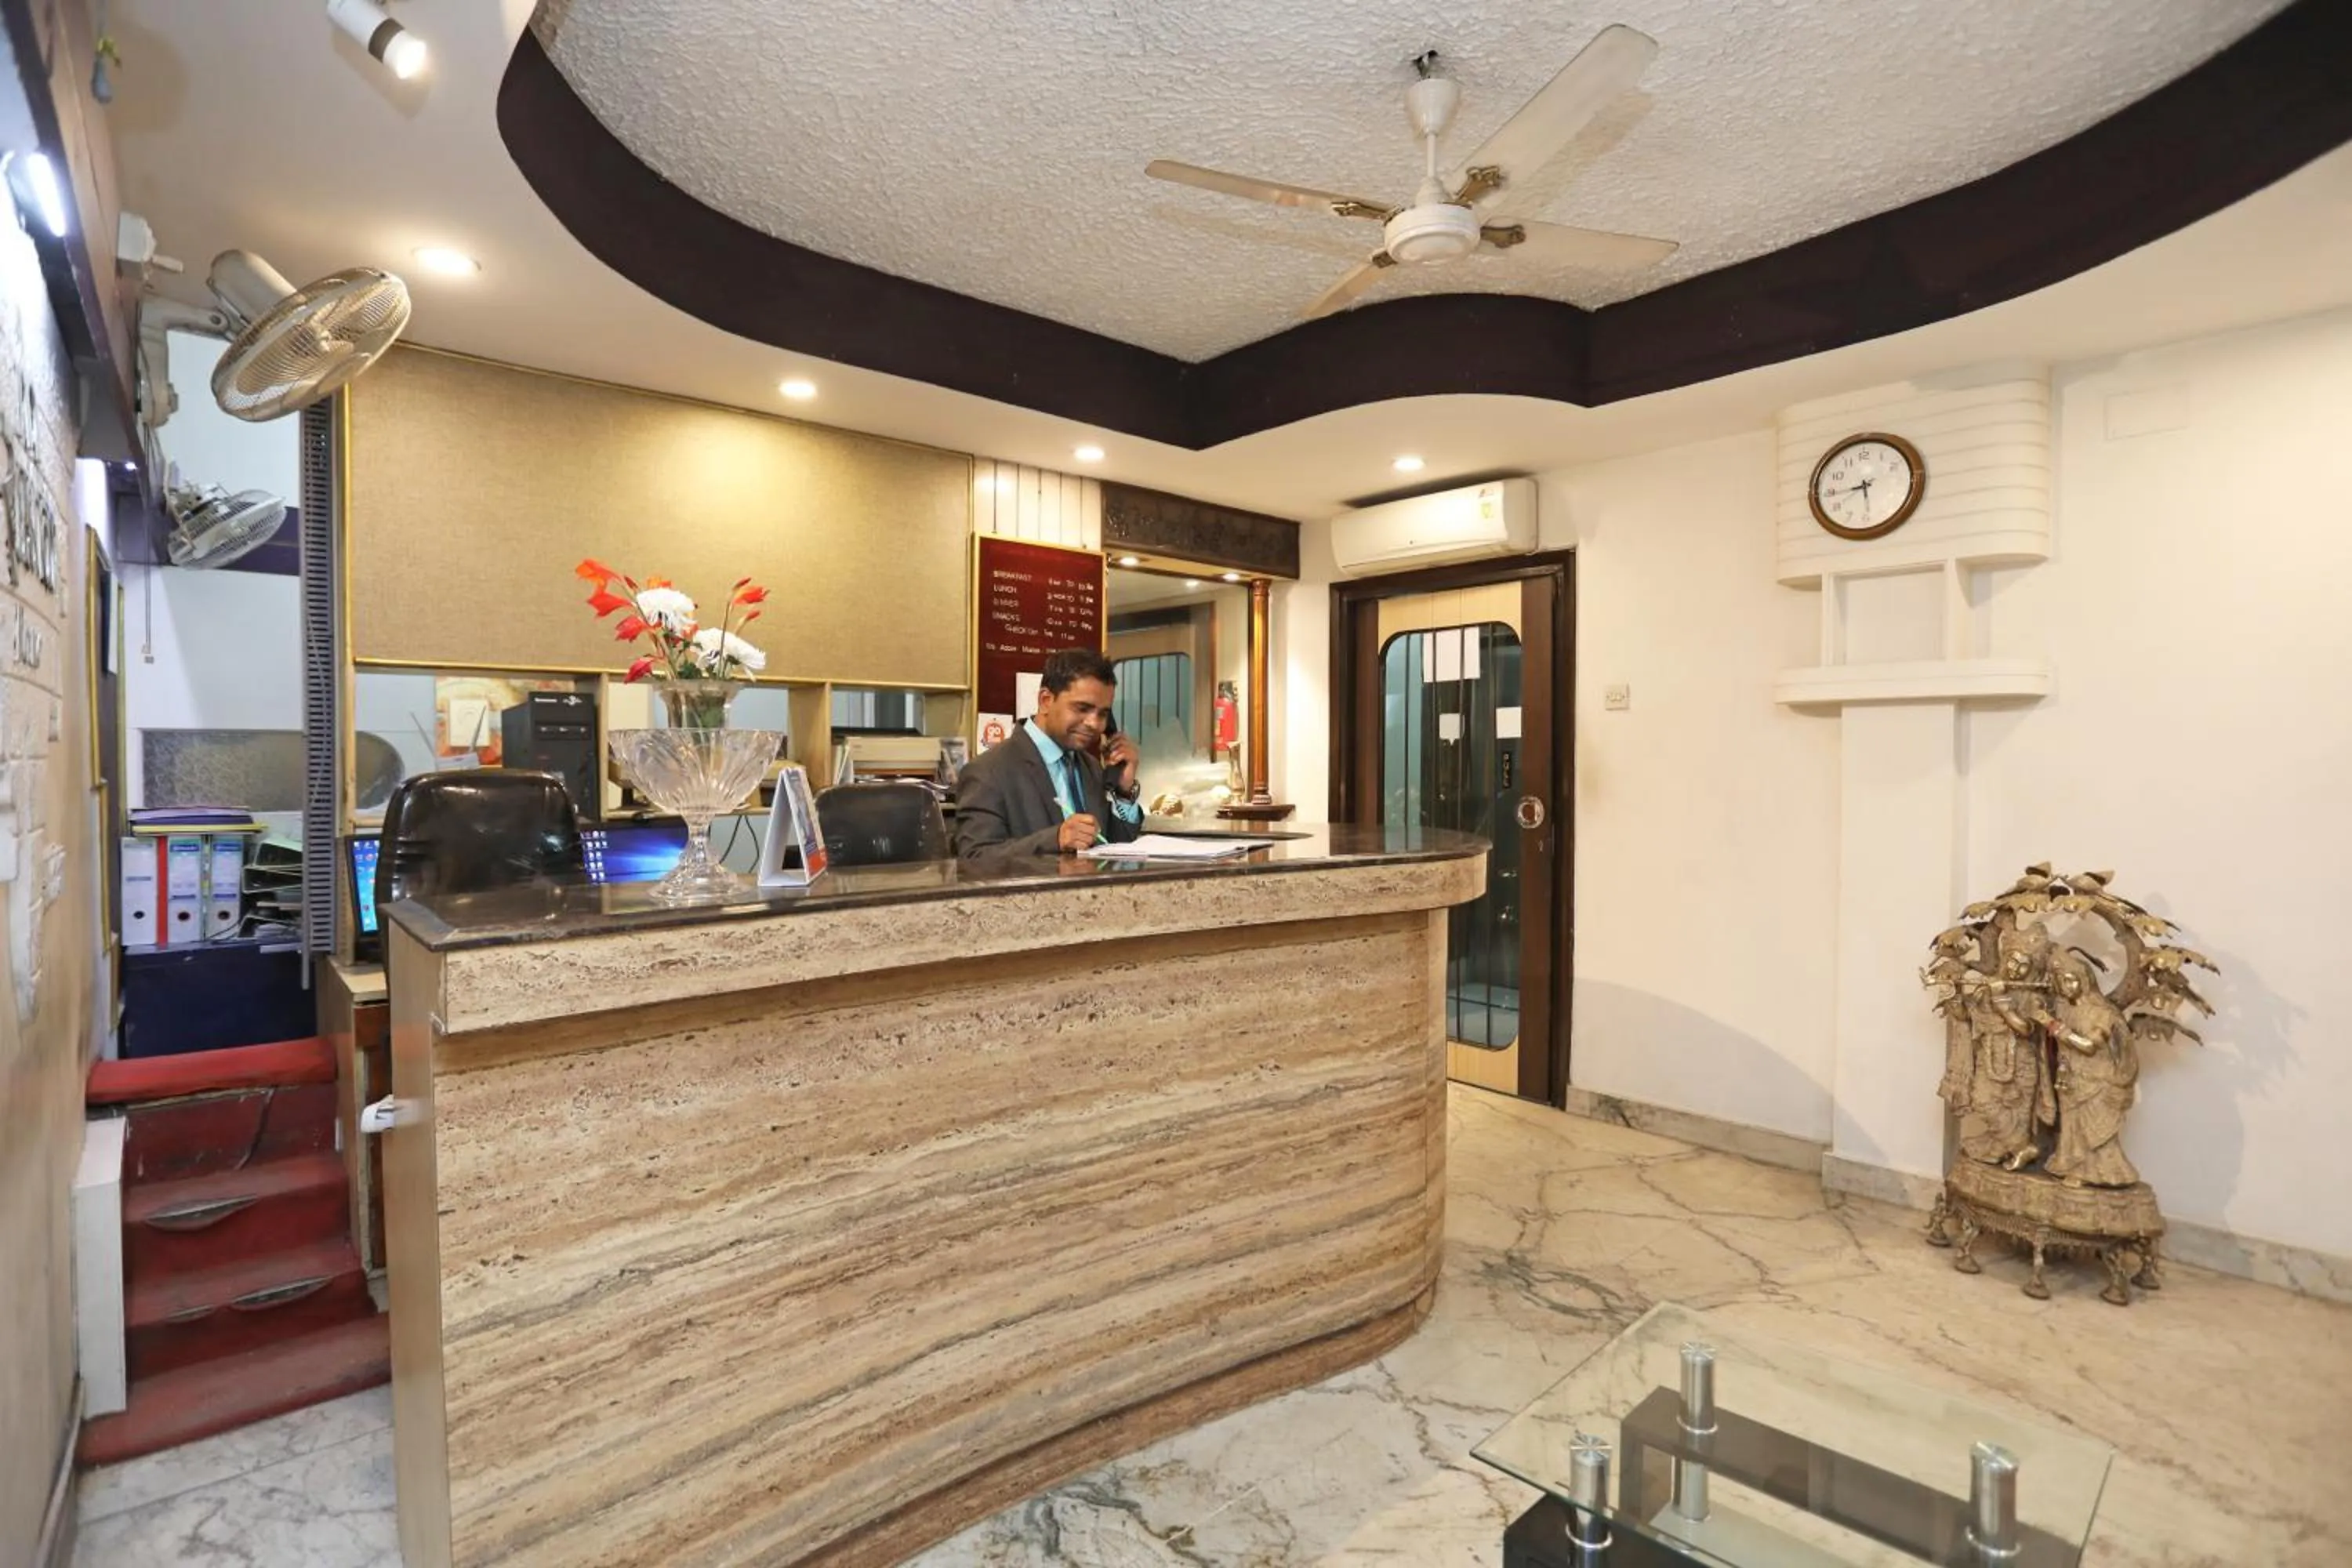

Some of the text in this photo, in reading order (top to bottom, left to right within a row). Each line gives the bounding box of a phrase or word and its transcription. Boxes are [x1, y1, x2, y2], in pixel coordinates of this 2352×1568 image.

[1859, 450, 1870, 462] 12
[1845, 458, 1853, 467] 11
[1832, 471, 1844, 481] 10
[993, 584, 1017, 593] LUNCH
